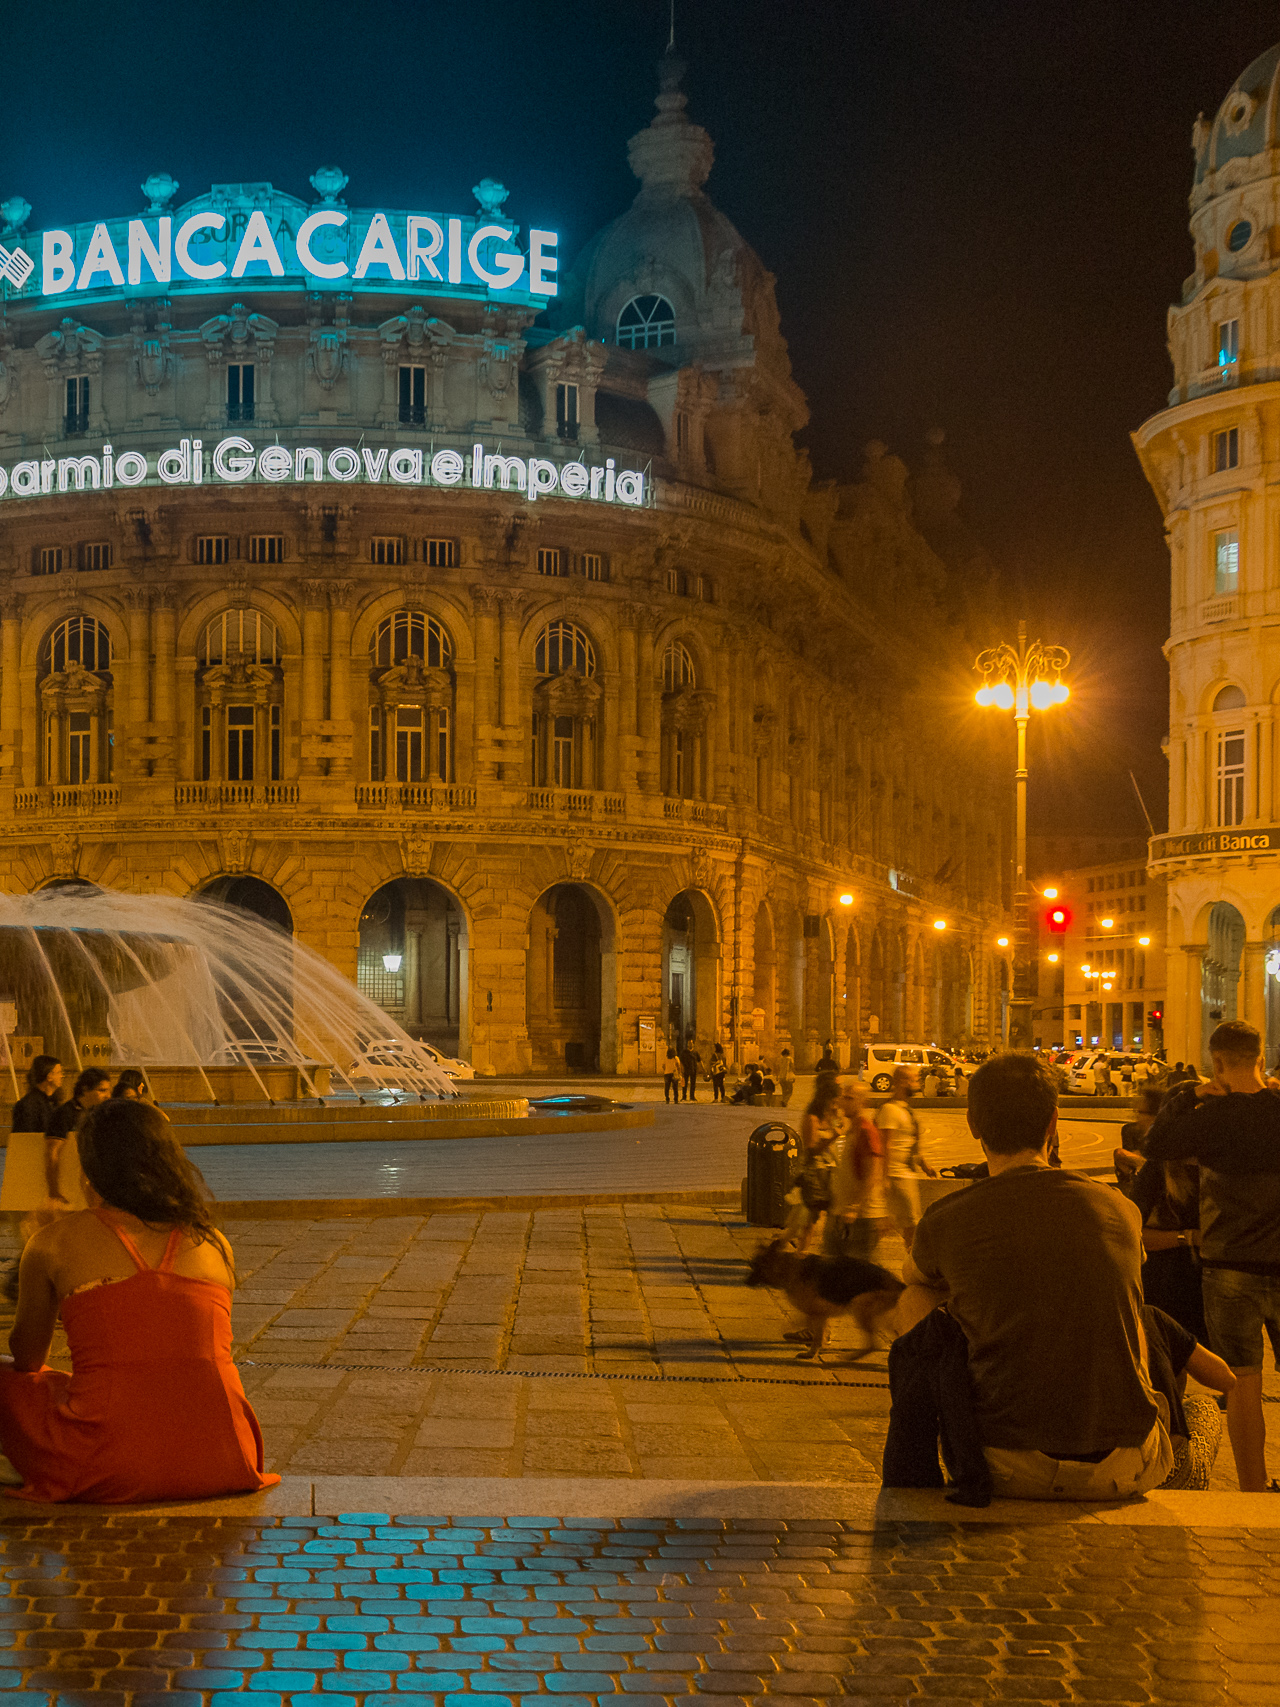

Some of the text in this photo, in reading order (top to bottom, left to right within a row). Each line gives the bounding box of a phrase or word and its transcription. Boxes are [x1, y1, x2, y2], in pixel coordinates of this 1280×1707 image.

[41, 210, 559, 296] BANCA CARIGE
[157, 438, 203, 485] di
[213, 436, 422, 484] Genova
[431, 449, 464, 485] e
[472, 443, 645, 506] Imperia
[1221, 835, 1269, 850] Banca
